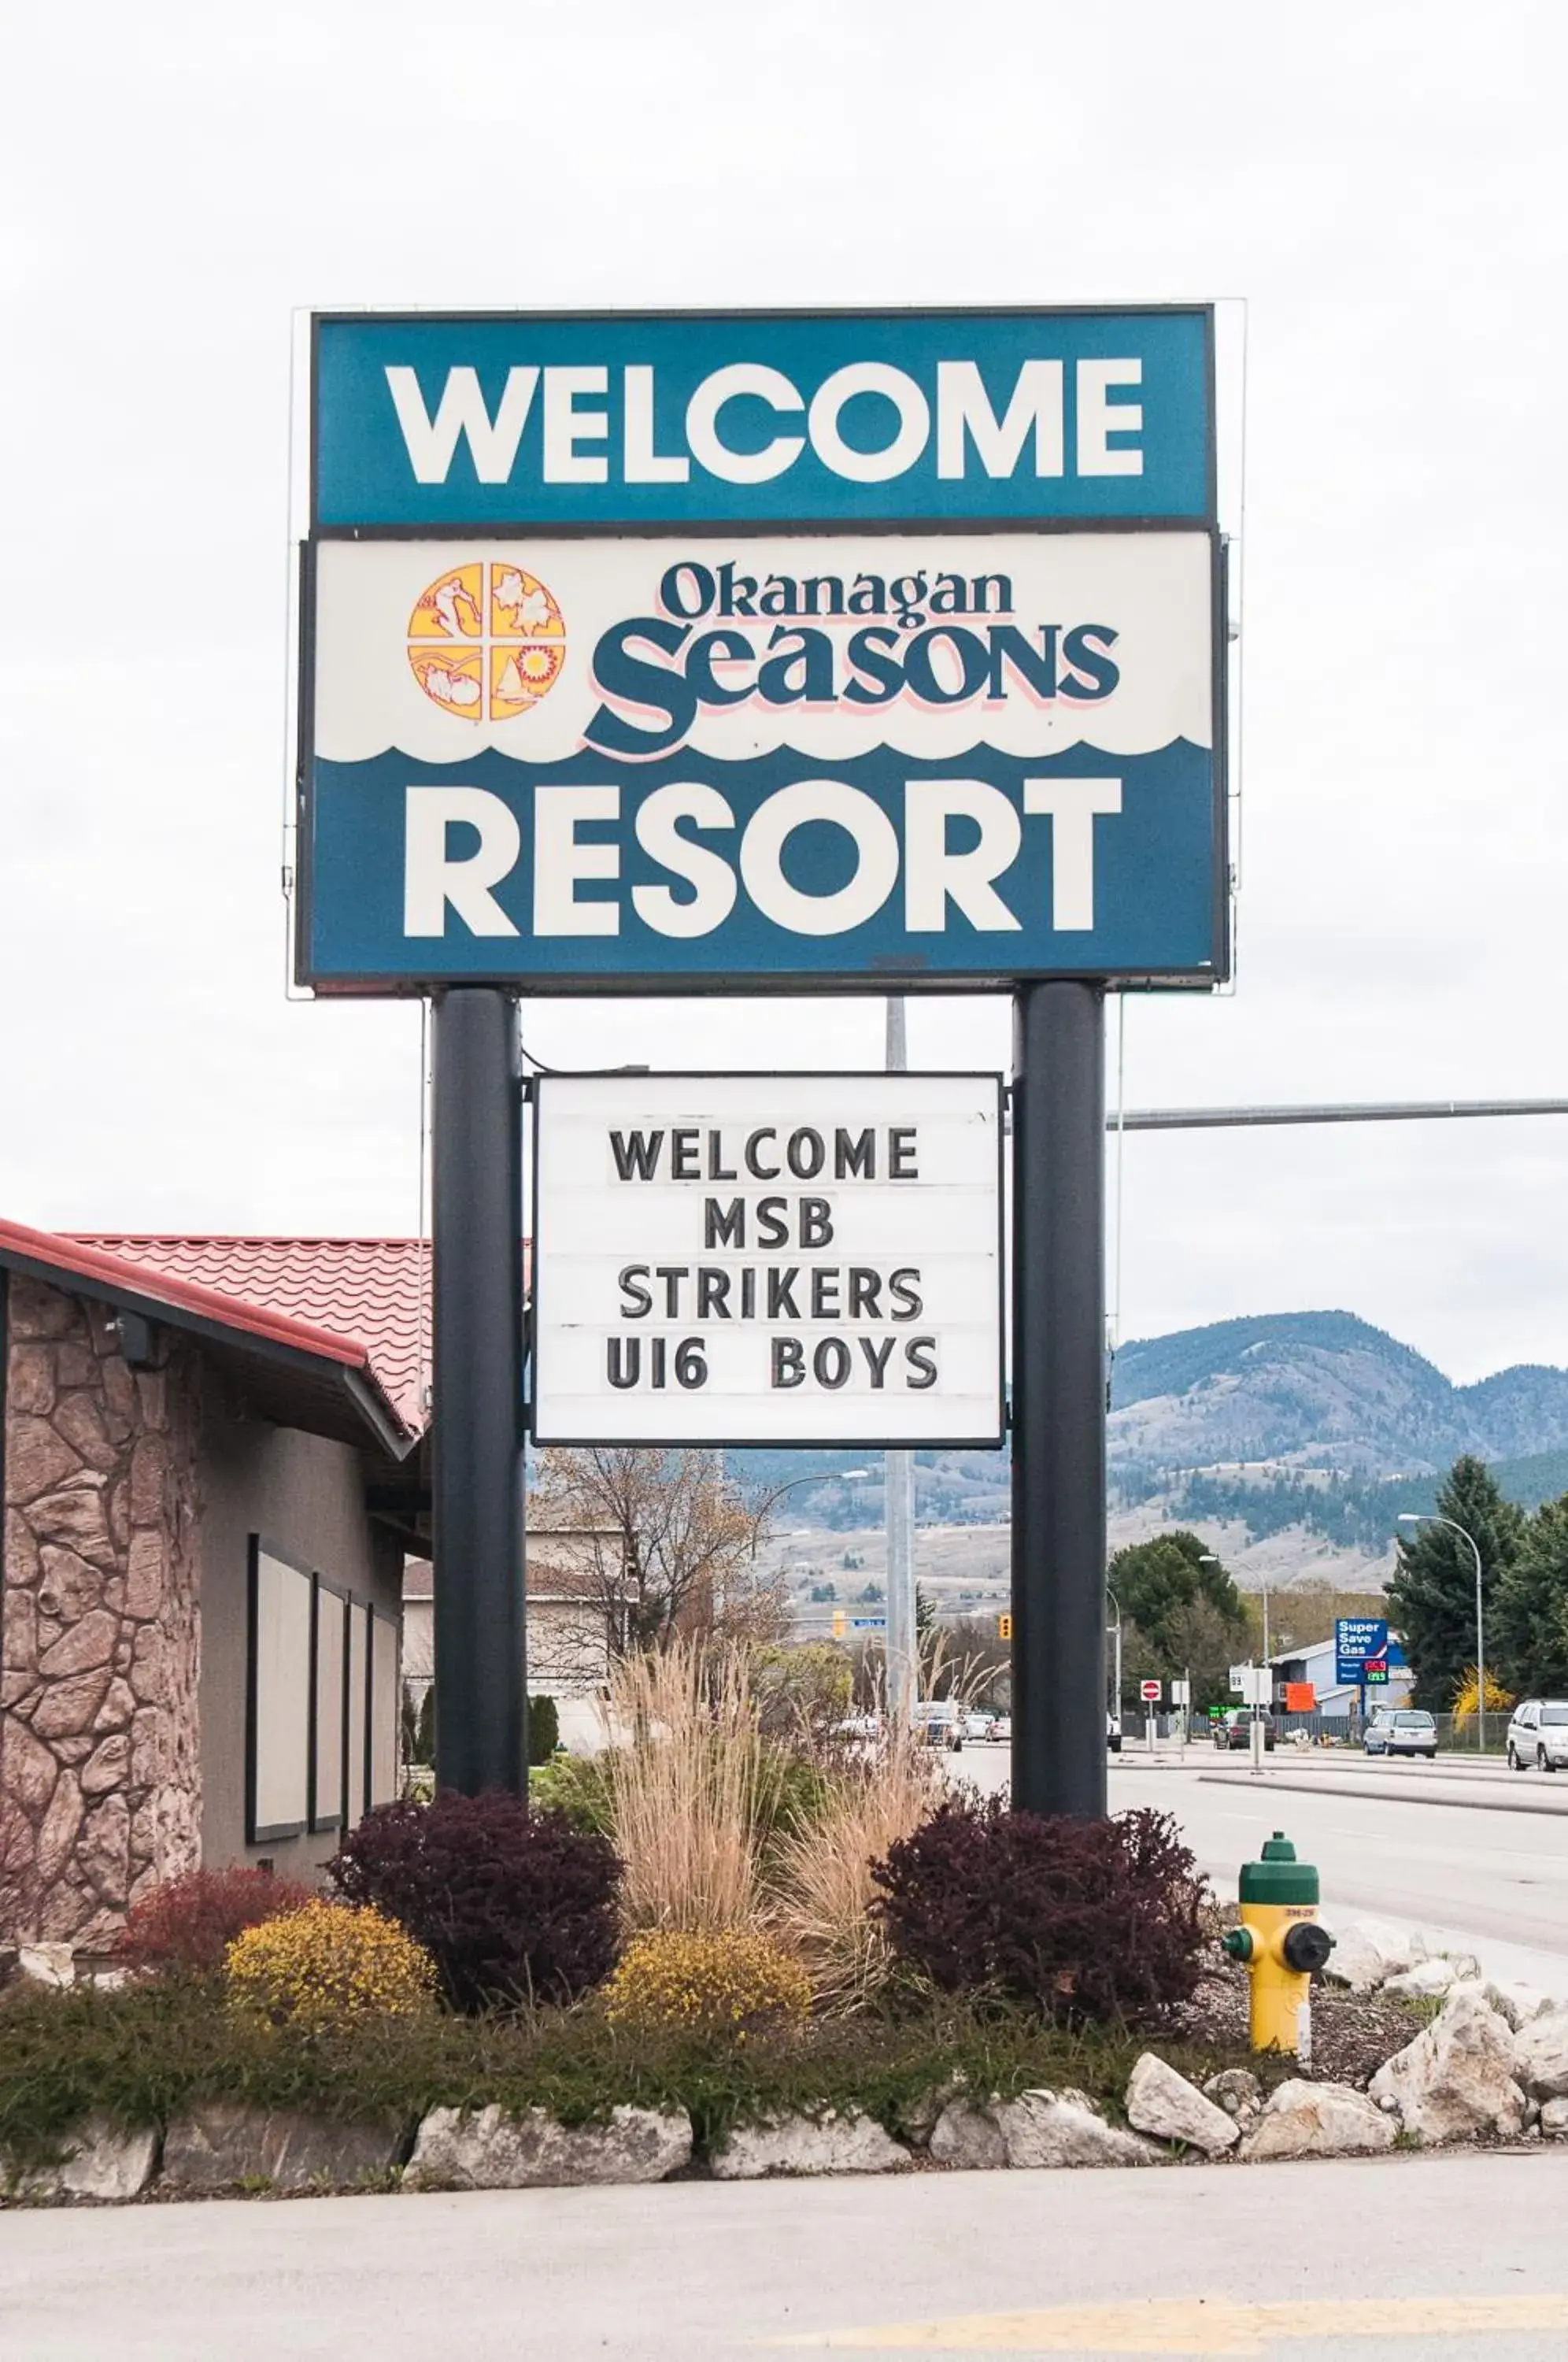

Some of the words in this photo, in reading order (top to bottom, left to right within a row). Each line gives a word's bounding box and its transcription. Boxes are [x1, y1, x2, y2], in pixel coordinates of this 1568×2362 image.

[384, 357, 1145, 484] WELCOME
[658, 560, 1015, 628] Okanagan
[402, 777, 1124, 939] RESORT
[609, 1126, 919, 1181] WELCOME
[704, 1196, 834, 1250] MSB
[618, 1265, 923, 1321] STRIKERS
[771, 1335, 937, 1390] BOYS
[1339, 1621, 1380, 1634] Super
[1339, 1633, 1372, 1643] Save
[1339, 1644, 1366, 1654] Gas
